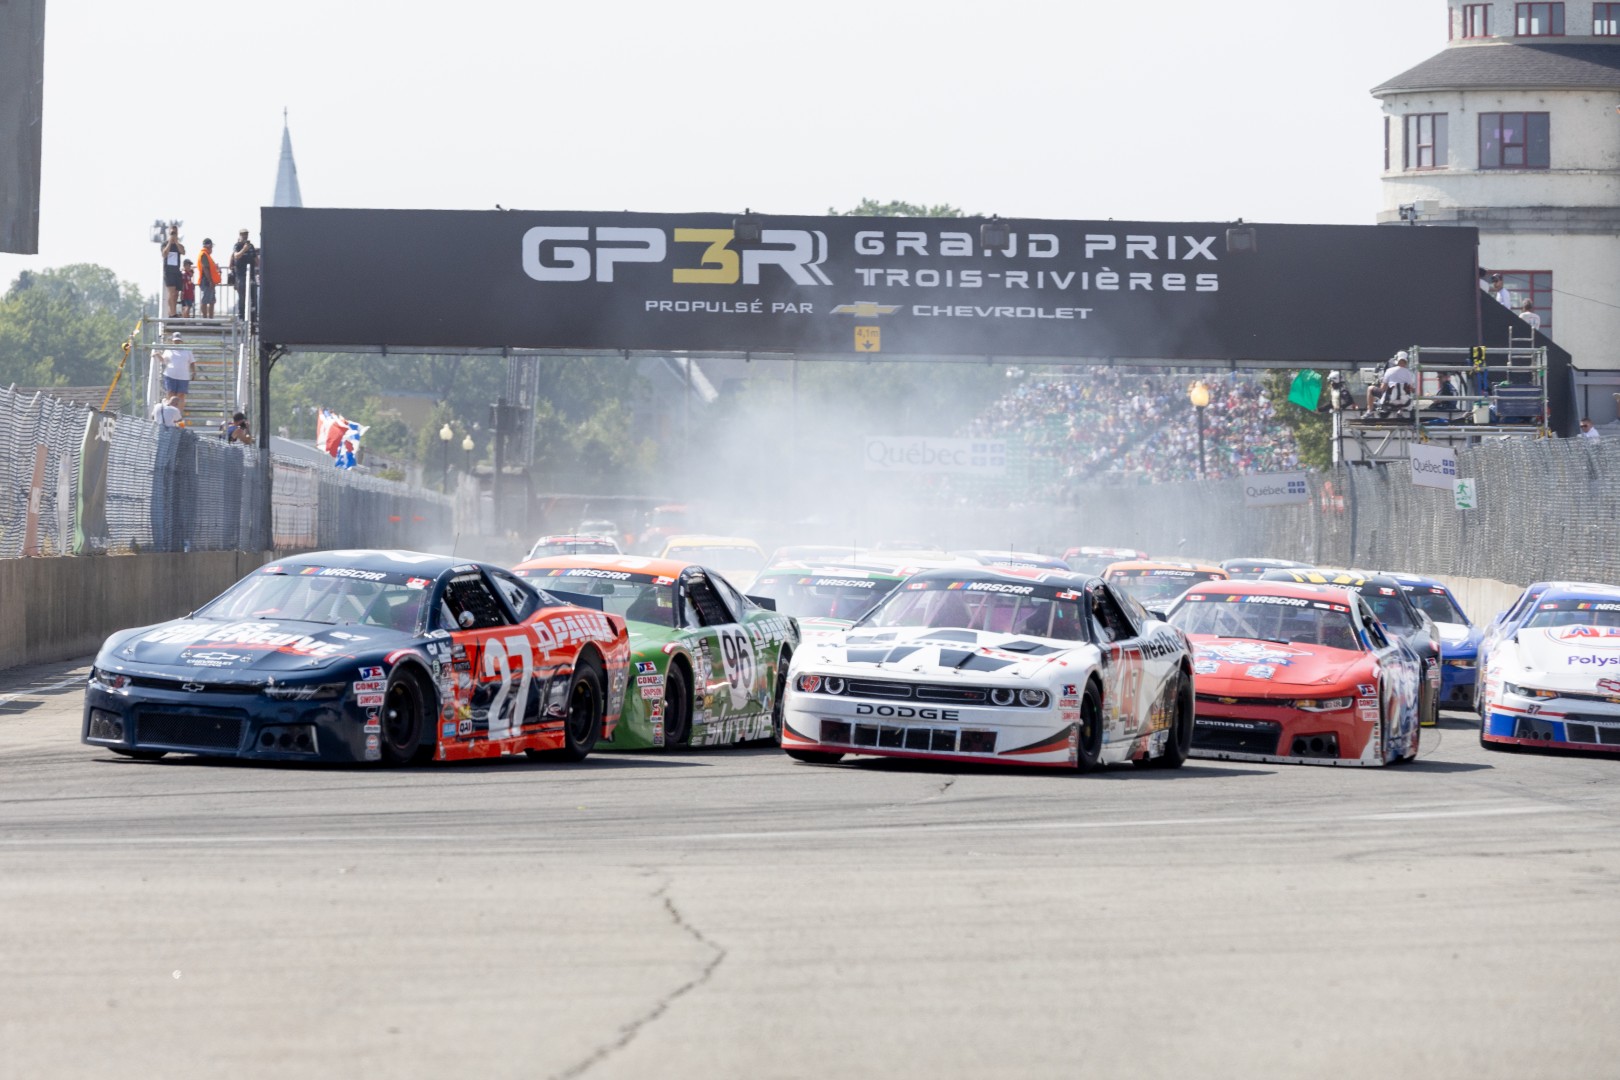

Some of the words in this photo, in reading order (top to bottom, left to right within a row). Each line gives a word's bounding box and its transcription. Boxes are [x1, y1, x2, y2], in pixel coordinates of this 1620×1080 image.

[1085, 234, 1218, 261] PRIX
[522, 226, 833, 286] GP3R
[645, 299, 763, 313] PROPULSÉ
[772, 303, 813, 314] PAR
[912, 305, 1093, 319] CHEVROLET
[867, 440, 967, 467] Québec
[1413, 456, 1441, 475] Québec
[1246, 485, 1286, 498] Québec
[320, 568, 387, 581] NASCAR
[566, 569, 631, 581] NASCAR
[816, 578, 876, 589] NASCAR
[967, 582, 1034, 595] NASCAR
[1245, 595, 1309, 607] NASCAR
[722, 629, 752, 690] 96
[1568, 655, 1620, 666] Polys
[639, 662, 654, 673] JE
[484, 634, 533, 741] 27
[803, 676, 822, 693] 47
[856, 703, 959, 722] DODGE
[1527, 704, 1541, 715] 87
